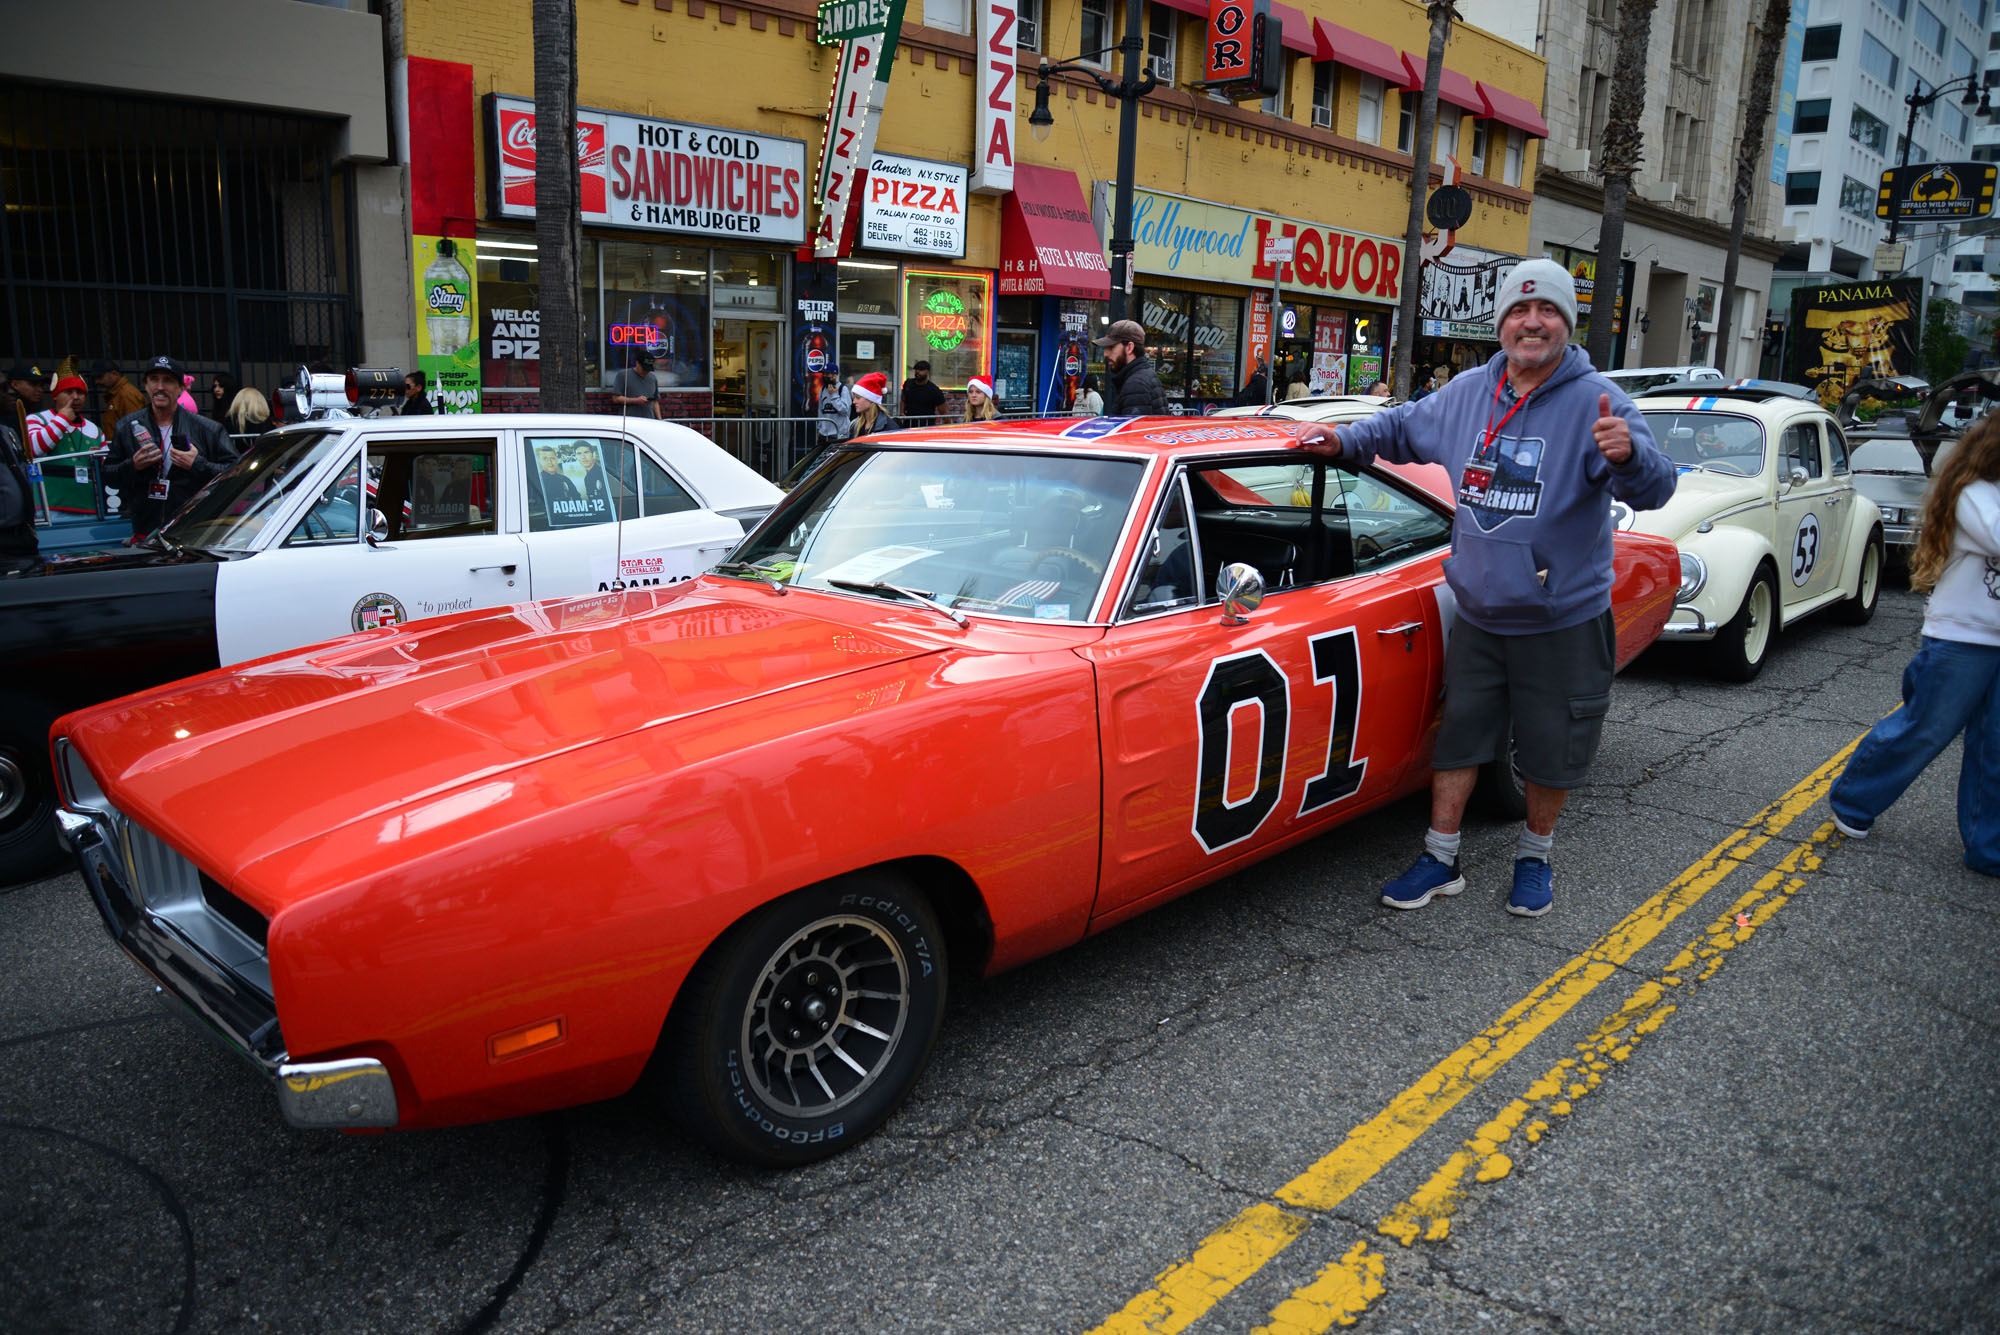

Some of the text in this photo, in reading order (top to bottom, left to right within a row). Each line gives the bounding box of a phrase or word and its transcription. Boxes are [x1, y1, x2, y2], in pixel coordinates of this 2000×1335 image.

[821, 0, 888, 36] ANDRES
[986, 3, 1016, 167] ZZA
[638, 124, 760, 161] HOT & COLD
[818, 46, 870, 242] PIZZA
[872, 160, 912, 176] Andre's
[934, 172, 960, 183] STYLE
[611, 144, 800, 218] SANDWICHES
[870, 177, 960, 214] PIZZA
[631, 204, 761, 233] & HAMBURGER
[876, 209, 908, 219] ITALIAN
[910, 213, 930, 222] FOOD
[867, 222, 888, 231] FREE
[913, 228, 951, 239] 462-1152
[867, 231, 902, 242] DELIVERY
[913, 236, 952, 248] 462-8995
[1266, 239, 1274, 247] NO
[1004, 259, 1038, 272] H & H
[1035, 246, 1108, 272] HOTEL & HOSTEL
[1252, 218, 1400, 298] LIQUOR
[1000, 278, 1044, 292] HOTEL & HOSTEL
[1574, 278, 1594, 289] LLYWOOD
[429, 286, 465, 312] Starry
[1256, 292, 1269, 301] TH
[1818, 285, 1894, 304] PANAMA
[798, 300, 834, 312] BETTER
[925, 292, 964, 314] NEW YORK
[935, 305, 955, 315] STYLE
[804, 310, 829, 322] WITH
[922, 315, 966, 330] PIZZA
[1061, 313, 1087, 323] BETTER
[1254, 314, 1266, 322] USE
[492, 323, 540, 338] AND
[1066, 322, 1083, 332] WITH
[1253, 324, 1266, 332] THE
[611, 326, 657, 344] OPEN
[1252, 334, 1268, 343] BEST
[491, 339, 540, 360] PIZ
[1317, 367, 1340, 380] Snack
[1362, 361, 1379, 373] Fruit
[1144, 423, 1278, 445] GENERAL
[553, 499, 605, 514] ADAM-12
[1794, 526, 1817, 578] 53
[620, 557, 663, 567] STAR CAR
[437, 597, 472, 615] protect
[1191, 625, 1369, 855] 01
[840, 894, 918, 934] Radial
